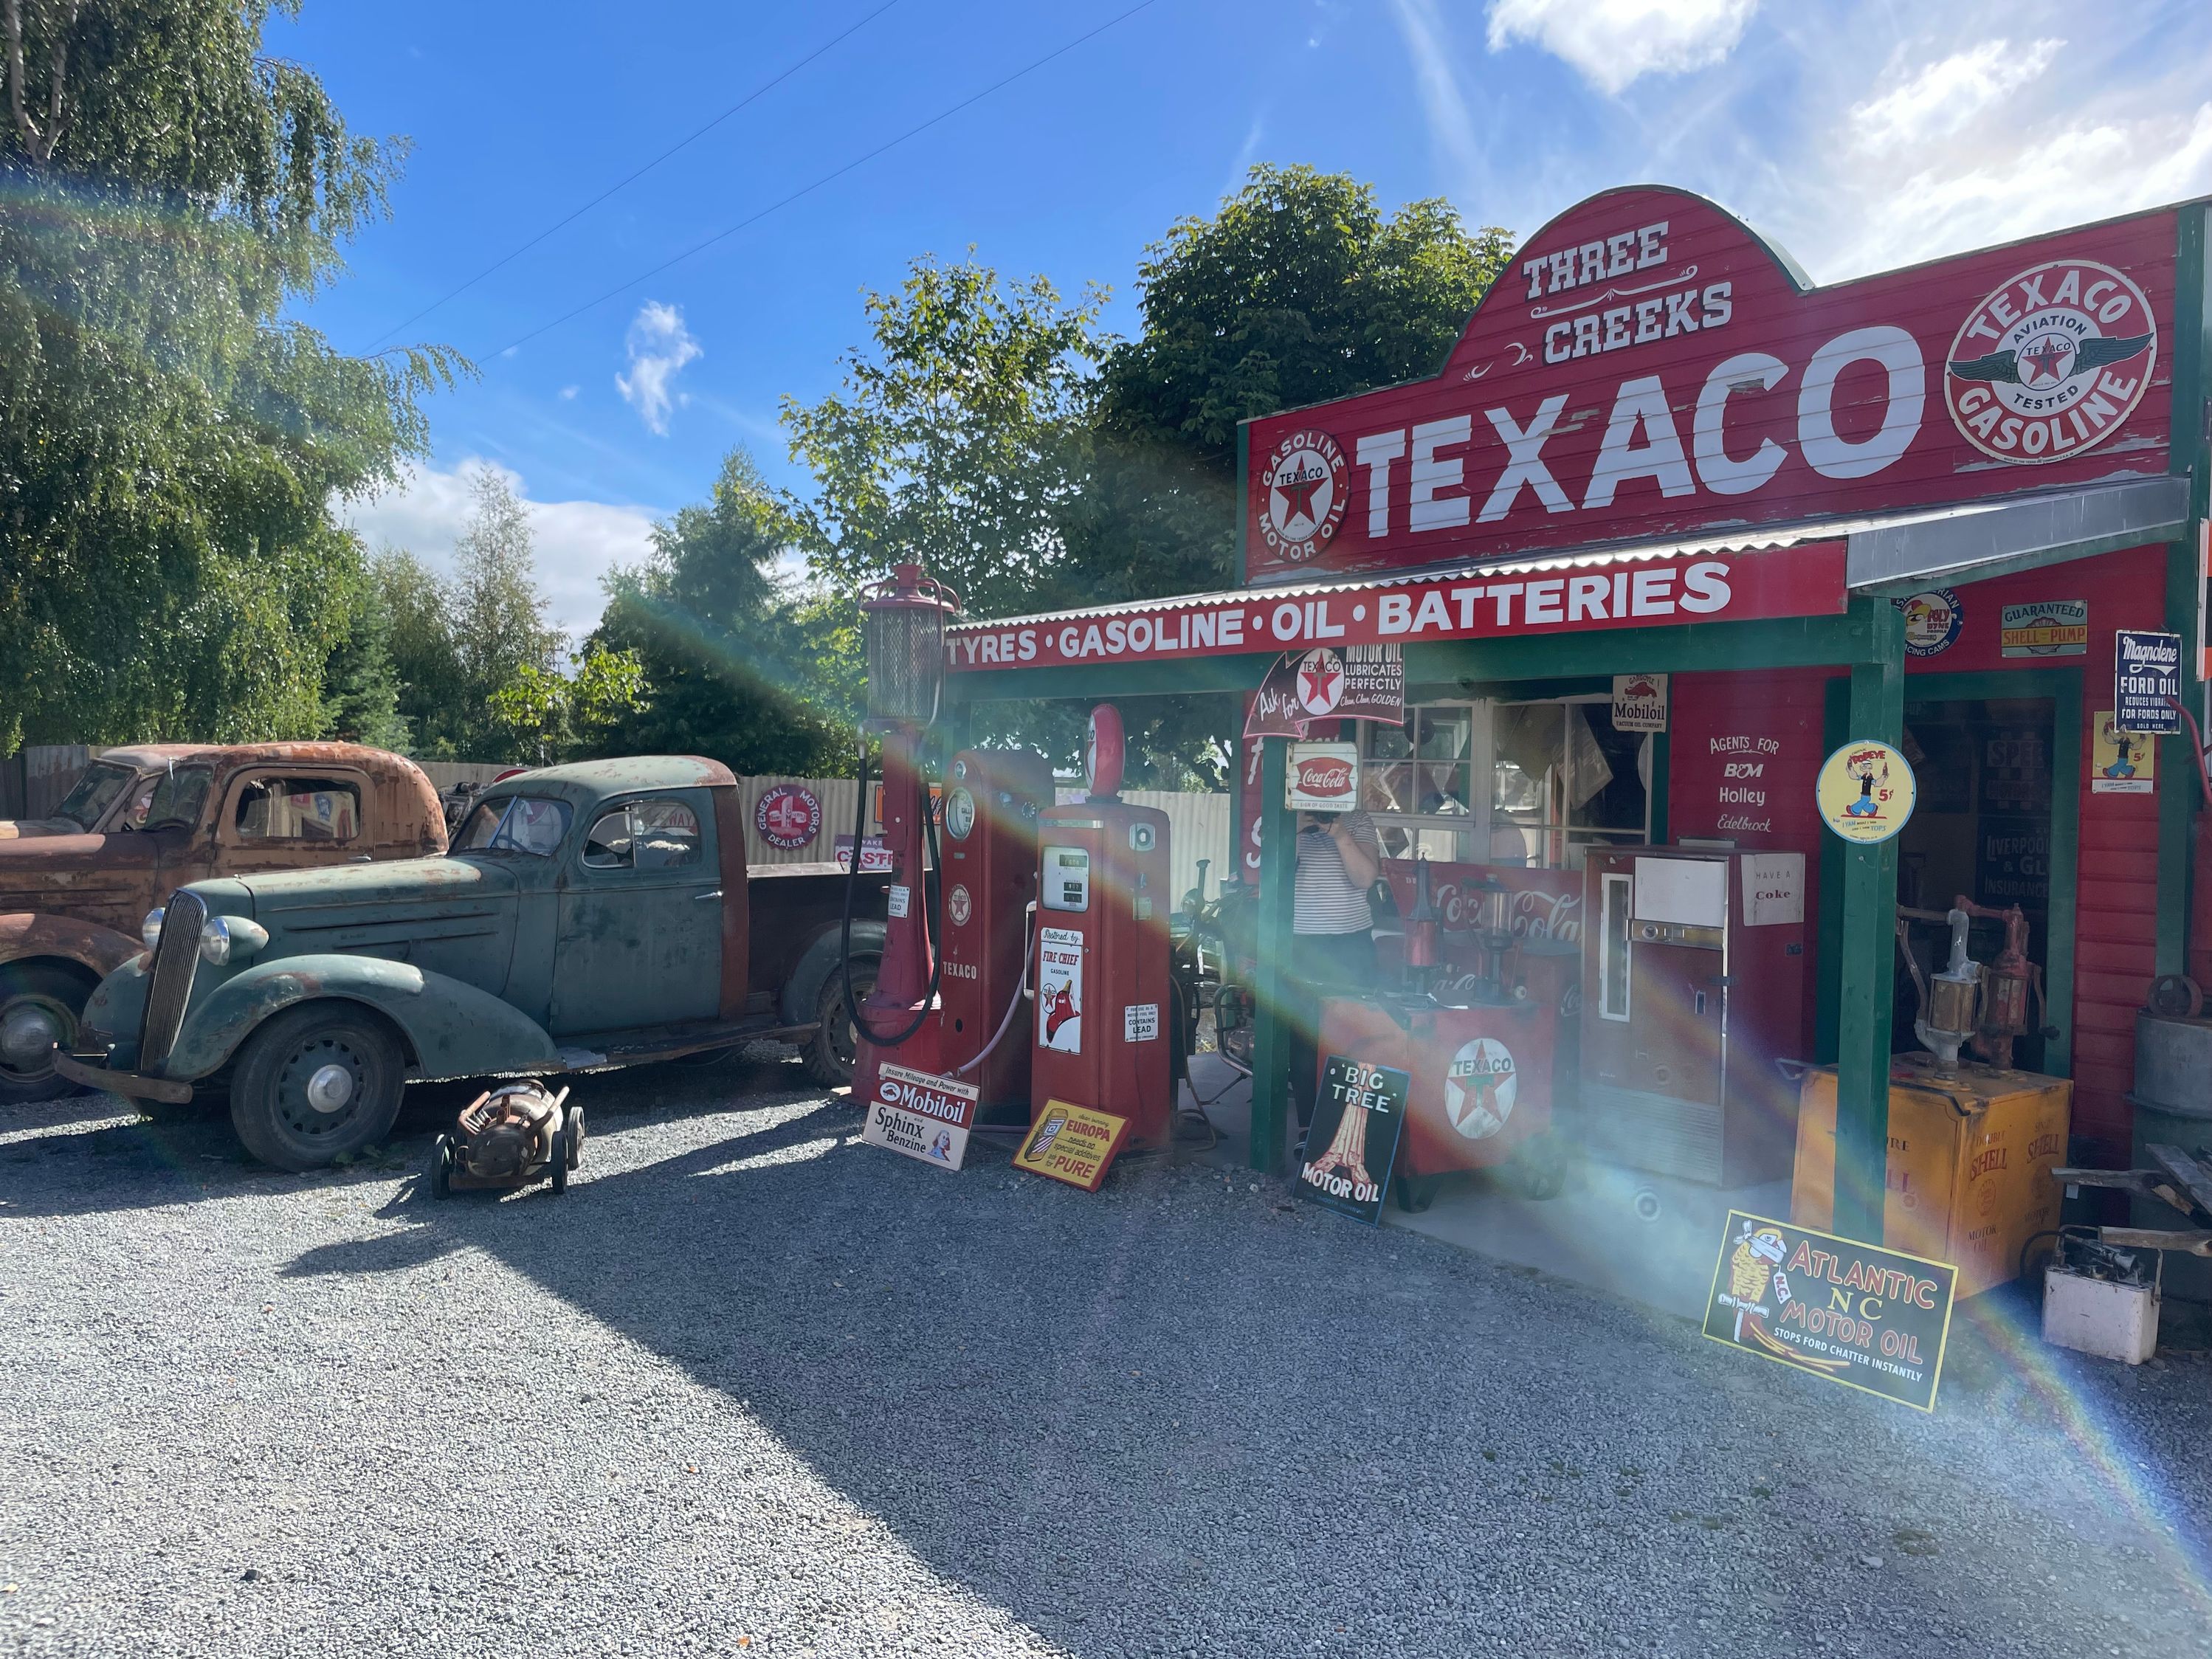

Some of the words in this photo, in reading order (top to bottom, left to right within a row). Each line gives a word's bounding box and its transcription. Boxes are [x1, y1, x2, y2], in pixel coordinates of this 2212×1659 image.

[1523, 221, 1669, 300] THREE
[1968, 270, 2132, 344] TEXACO
[1544, 281, 1732, 365] CREEKS
[2013, 315, 2087, 344] AVIATION
[2027, 342, 2070, 356] TEXACO
[2013, 385, 2078, 410] TESTED
[1959, 371, 2137, 455] GASOLINE
[1356, 325, 1926, 538] TEXACO
[1263, 432, 1344, 487] GASOLINE
[1279, 466, 1323, 485] TEXACO
[1259, 512, 1316, 560] MOTOR
[1321, 499, 1346, 539] OIL
[945, 630, 1036, 665] TYRES
[1058, 608, 1244, 658] GASOLINE
[1271, 601, 1345, 642] OIL
[1378, 561, 1732, 635] BATTERIES
[2005, 604, 2084, 622] GUARANTEED
[2004, 630, 2039, 644] SHELL
[2050, 627, 2085, 642] PUMP
[1346, 644, 1382, 663] MOTOR
[1385, 644, 1402, 663] OIL
[1928, 639, 1949, 655] CAMS
[2123, 636, 2177, 668] Magnolene
[1303, 661, 1340, 673] TEXACO
[1345, 664, 1402, 676] LUBRICATES
[1345, 678, 1401, 690] PERFECTLY
[2120, 677, 2154, 694] FORD
[2159, 678, 2177, 695] OIL
[1261, 688, 1281, 721] Ask
[1282, 693, 1299, 720] for
[1371, 694, 1402, 707] GOLDEN
[2126, 697, 2149, 706] REDUCES
[1614, 703, 1664, 720] Mobiloil
[2122, 709, 2136, 719] FOR
[2137, 709, 2159, 720] FORDS
[2161, 710, 2177, 720] ONLY
[1710, 737, 1750, 755] AGENTS
[1757, 738, 1779, 755] FOR
[1724, 763, 1764, 779] B&M
[1719, 787, 1765, 807] Holley
[758, 787, 787, 830] GENERAL
[800, 790, 820, 834] MOTORS
[1717, 814, 1771, 833] Edelbrock
[768, 834, 806, 846] DEALER
[2019, 856, 2050, 875] GL
[1756, 871, 1781, 880] HAVE
[1756, 890, 1791, 900] Coke
[1985, 874, 2049, 898] INSURANCE
[1044, 929, 1069, 940] Restored
[1071, 932, 1080, 944] by
[1043, 951, 1058, 962] FIRE
[1058, 953, 1079, 966] CHIEF
[943, 962, 977, 980] TEXACO
[1129, 1017, 1155, 1025] CONTAINS
[1133, 1025, 1151, 1034] LEAD
[1453, 1058, 1512, 1075] TEXACO
[886, 1066, 903, 1077] Insure
[905, 1072, 926, 1084] Mileage
[926, 1079, 937, 1087] and
[939, 1082, 957, 1092] Power
[957, 1087, 969, 1096] with
[899, 1084, 966, 1123] Mobiloil
[875, 1107, 925, 1139] Sphinx
[1066, 1120, 1111, 1142] EUROPA
[886, 1130, 926, 1153] Benzine
[2027, 1134, 2059, 1164] SHELL
[1053, 1143, 1074, 1153] special
[1075, 1148, 1101, 1162] additives
[1971, 1148, 2007, 1181] SHELL
[1302, 1162, 1353, 1198] MOTOR
[1355, 1183, 1379, 1201] OIL
[1968, 1224, 1996, 1241] MOTOR
[1787, 1241, 1937, 1309] ATLANTIC
[1780, 1300, 1873, 1348] MOTOR
[1881, 1330, 1923, 1365] OIL
[1774, 1328, 1800, 1343] STOPS
[1802, 1337, 1827, 1351] FORD
[1830, 1345, 1870, 1365] CHATTER
[1872, 1359, 1923, 1383] INSTANTLY
